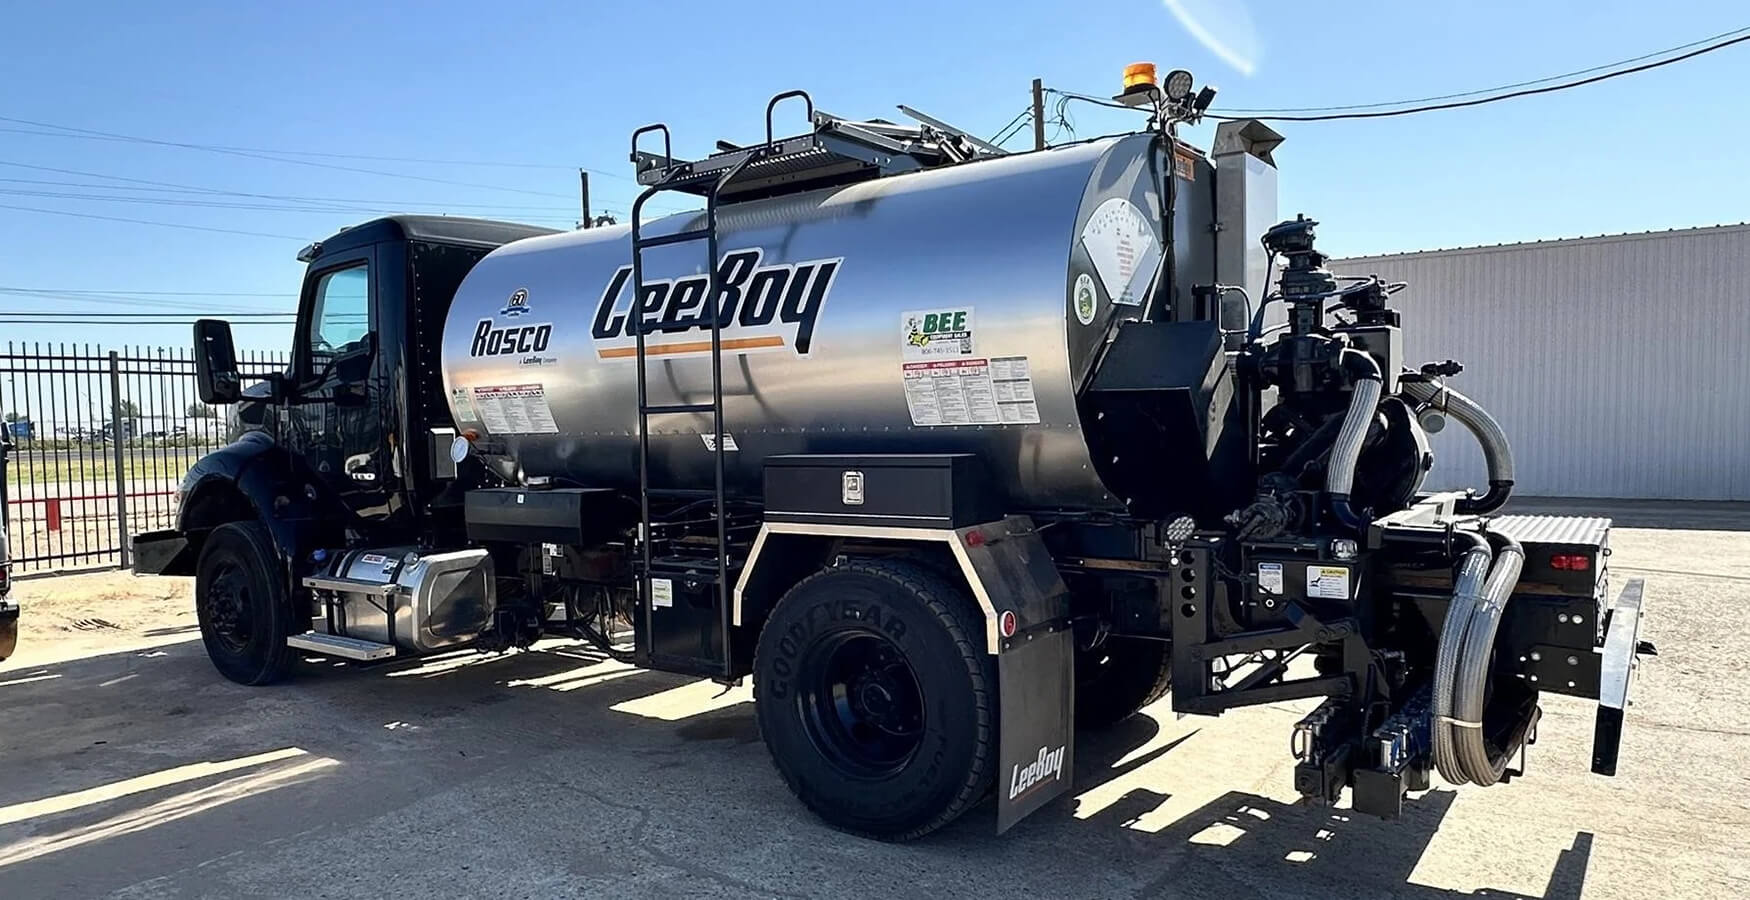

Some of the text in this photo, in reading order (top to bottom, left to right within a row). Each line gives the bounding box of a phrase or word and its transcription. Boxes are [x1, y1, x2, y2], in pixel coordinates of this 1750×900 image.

[591, 250, 842, 355] LeeBoy
[923, 311, 967, 333] BEE
[471, 320, 552, 357] Rosco
[772, 601, 906, 698] GOODYEAR
[1009, 746, 1065, 799] LeeBoy
